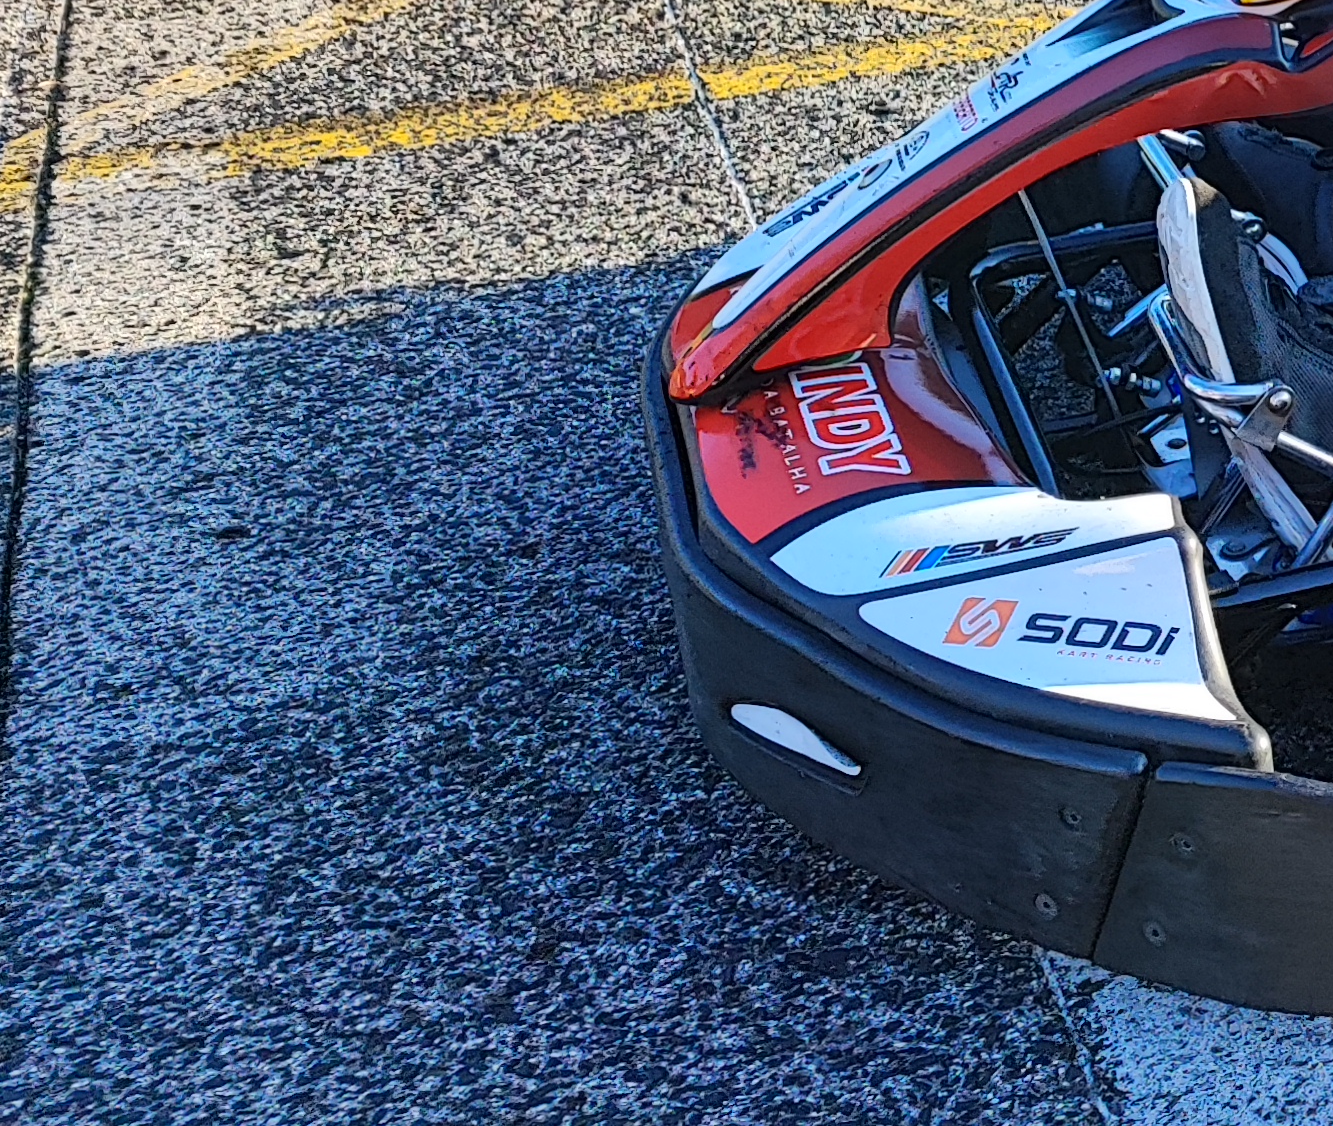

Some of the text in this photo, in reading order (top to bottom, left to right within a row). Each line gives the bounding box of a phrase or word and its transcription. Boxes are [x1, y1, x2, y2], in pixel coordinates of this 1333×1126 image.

[770, 405, 811, 496] BATALHA
[938, 526, 1080, 564] SWS
[1056, 649, 1162, 666] KART RACING
